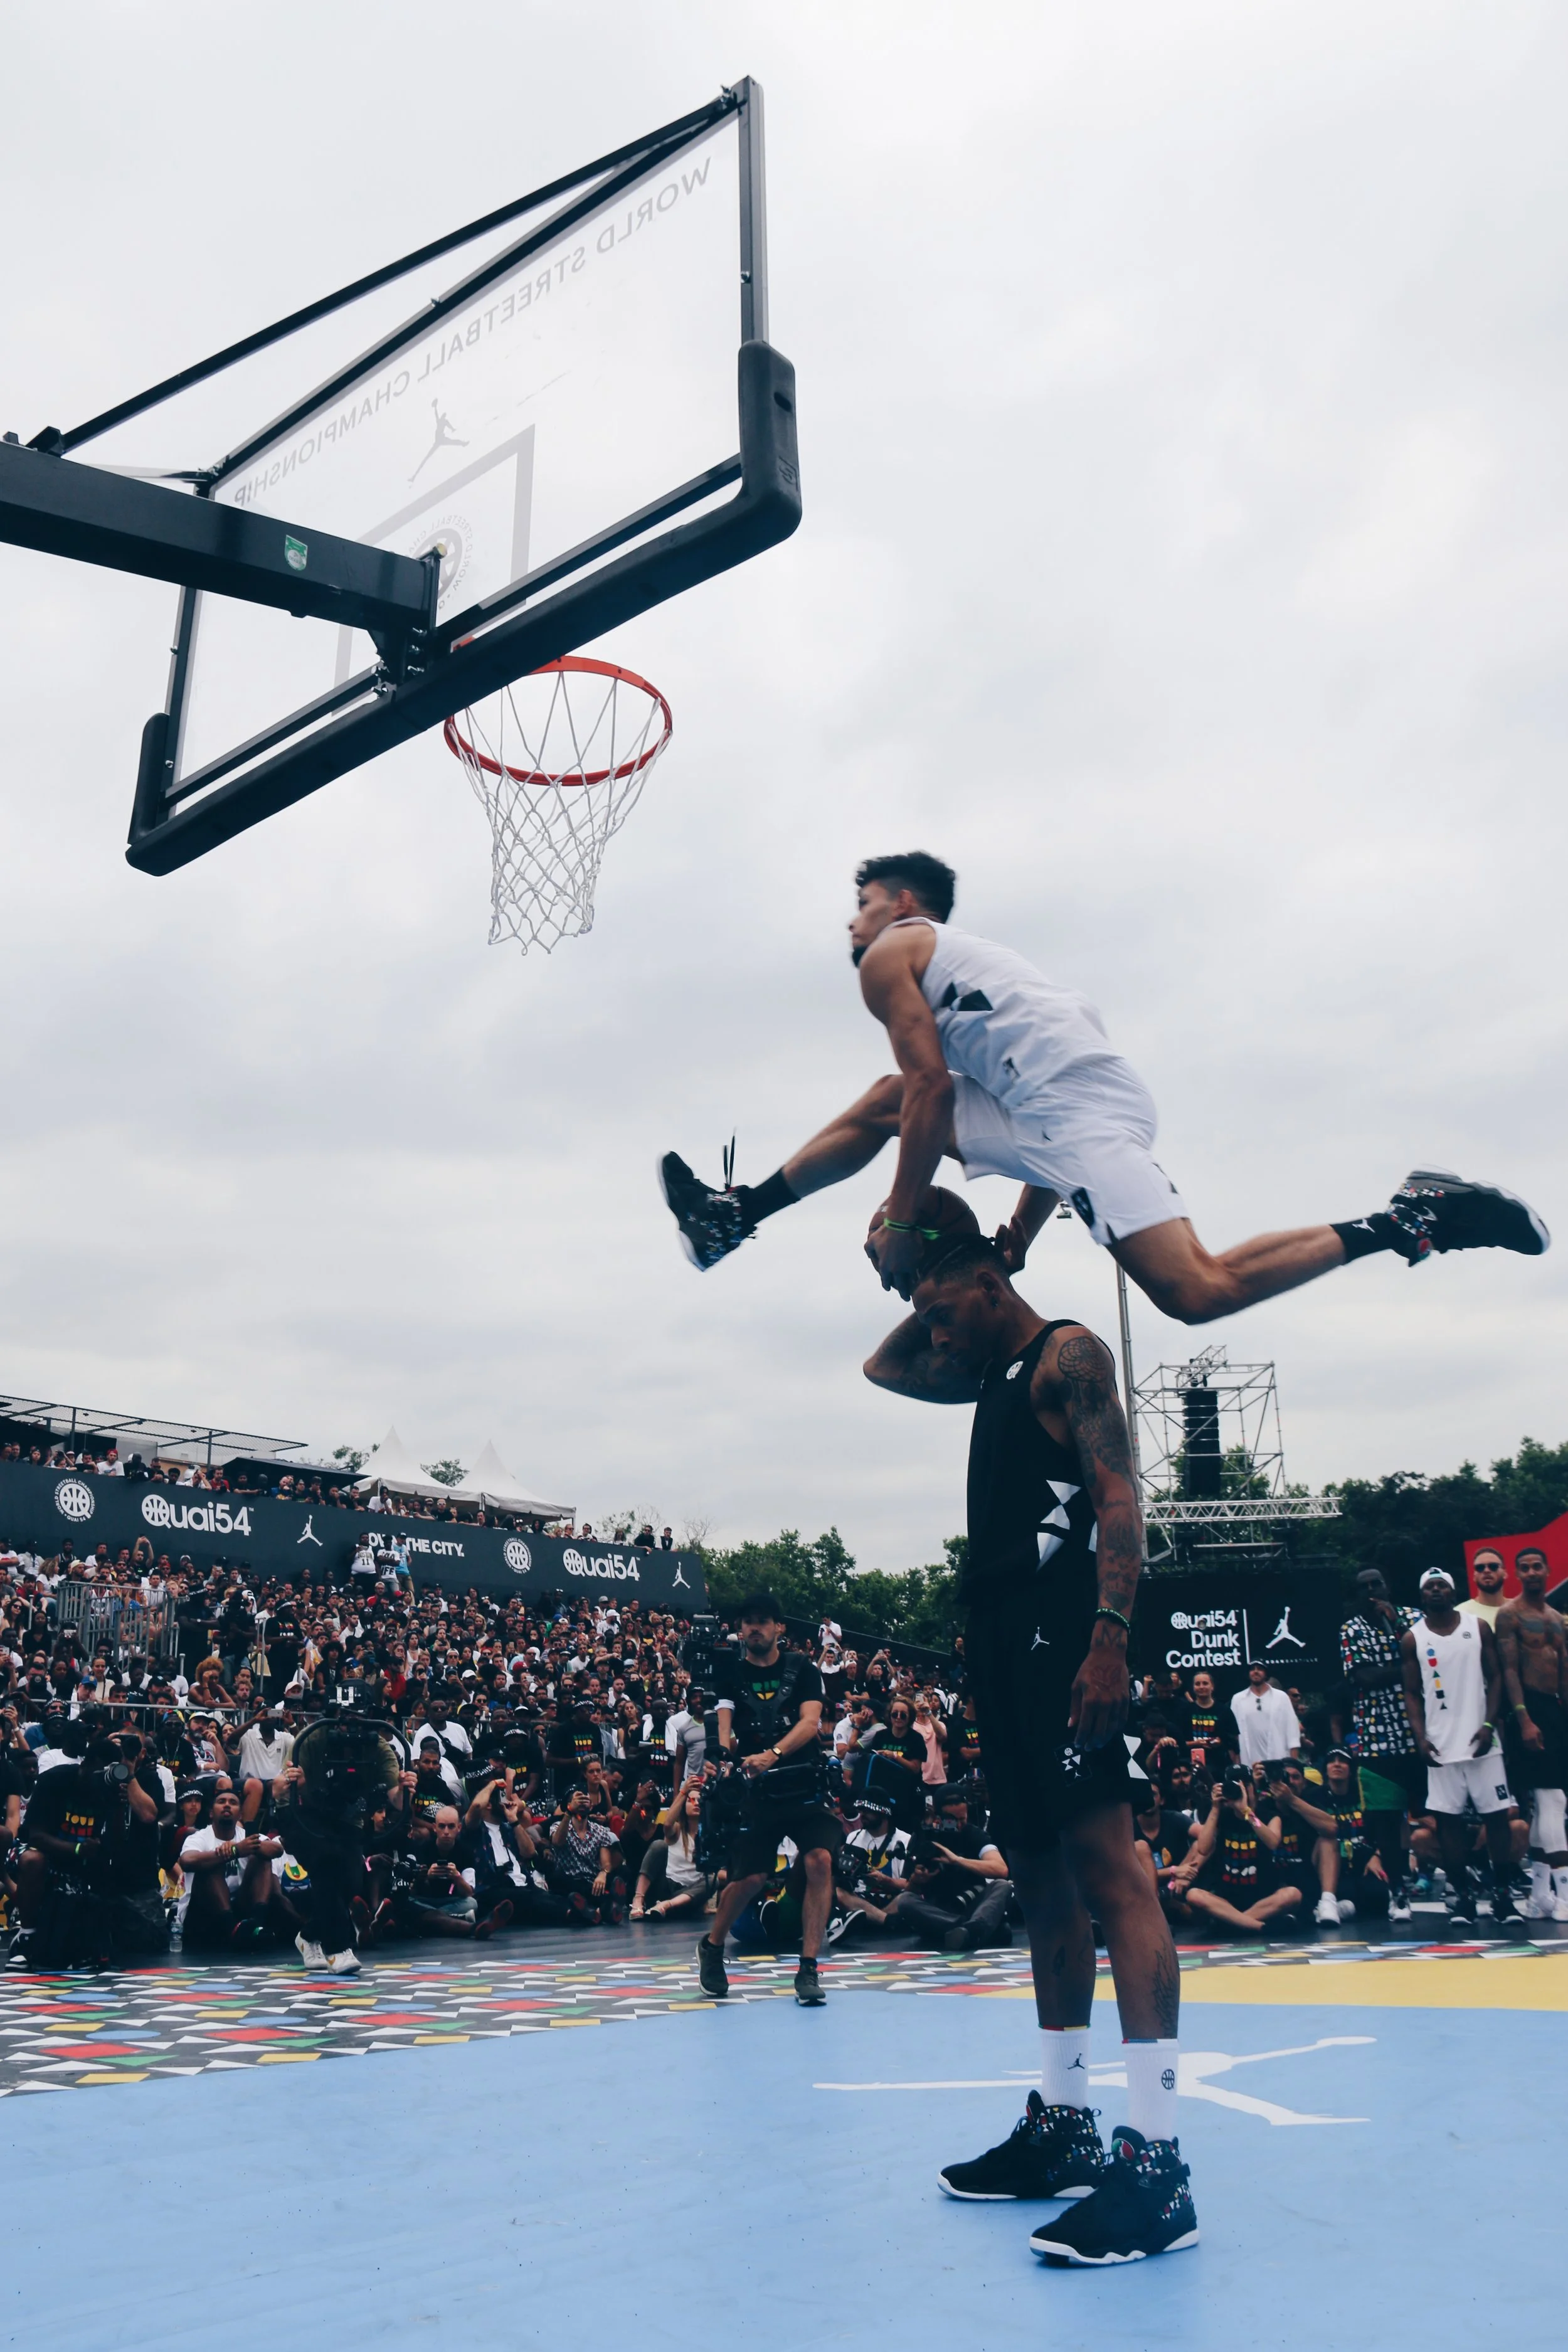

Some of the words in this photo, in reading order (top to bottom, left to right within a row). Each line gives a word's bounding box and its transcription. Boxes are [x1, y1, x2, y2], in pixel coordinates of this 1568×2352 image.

[55, 1478, 77, 1495] STREETBALL
[55, 1495, 65, 1515] WORLD
[78, 1480, 95, 1515] CHAMPIONSHIP
[142, 1494, 252, 1536] Quai54
[405, 1537, 432, 1554] THE
[432, 1540, 465, 1557] CITY.
[563, 1548, 640, 1581] Quai54
[1171, 1610, 1238, 1629] Quai54
[1191, 1629, 1240, 1648] Dunk
[1166, 1648, 1242, 1668] Contest
[65, 1811, 94, 1826] YOUR
